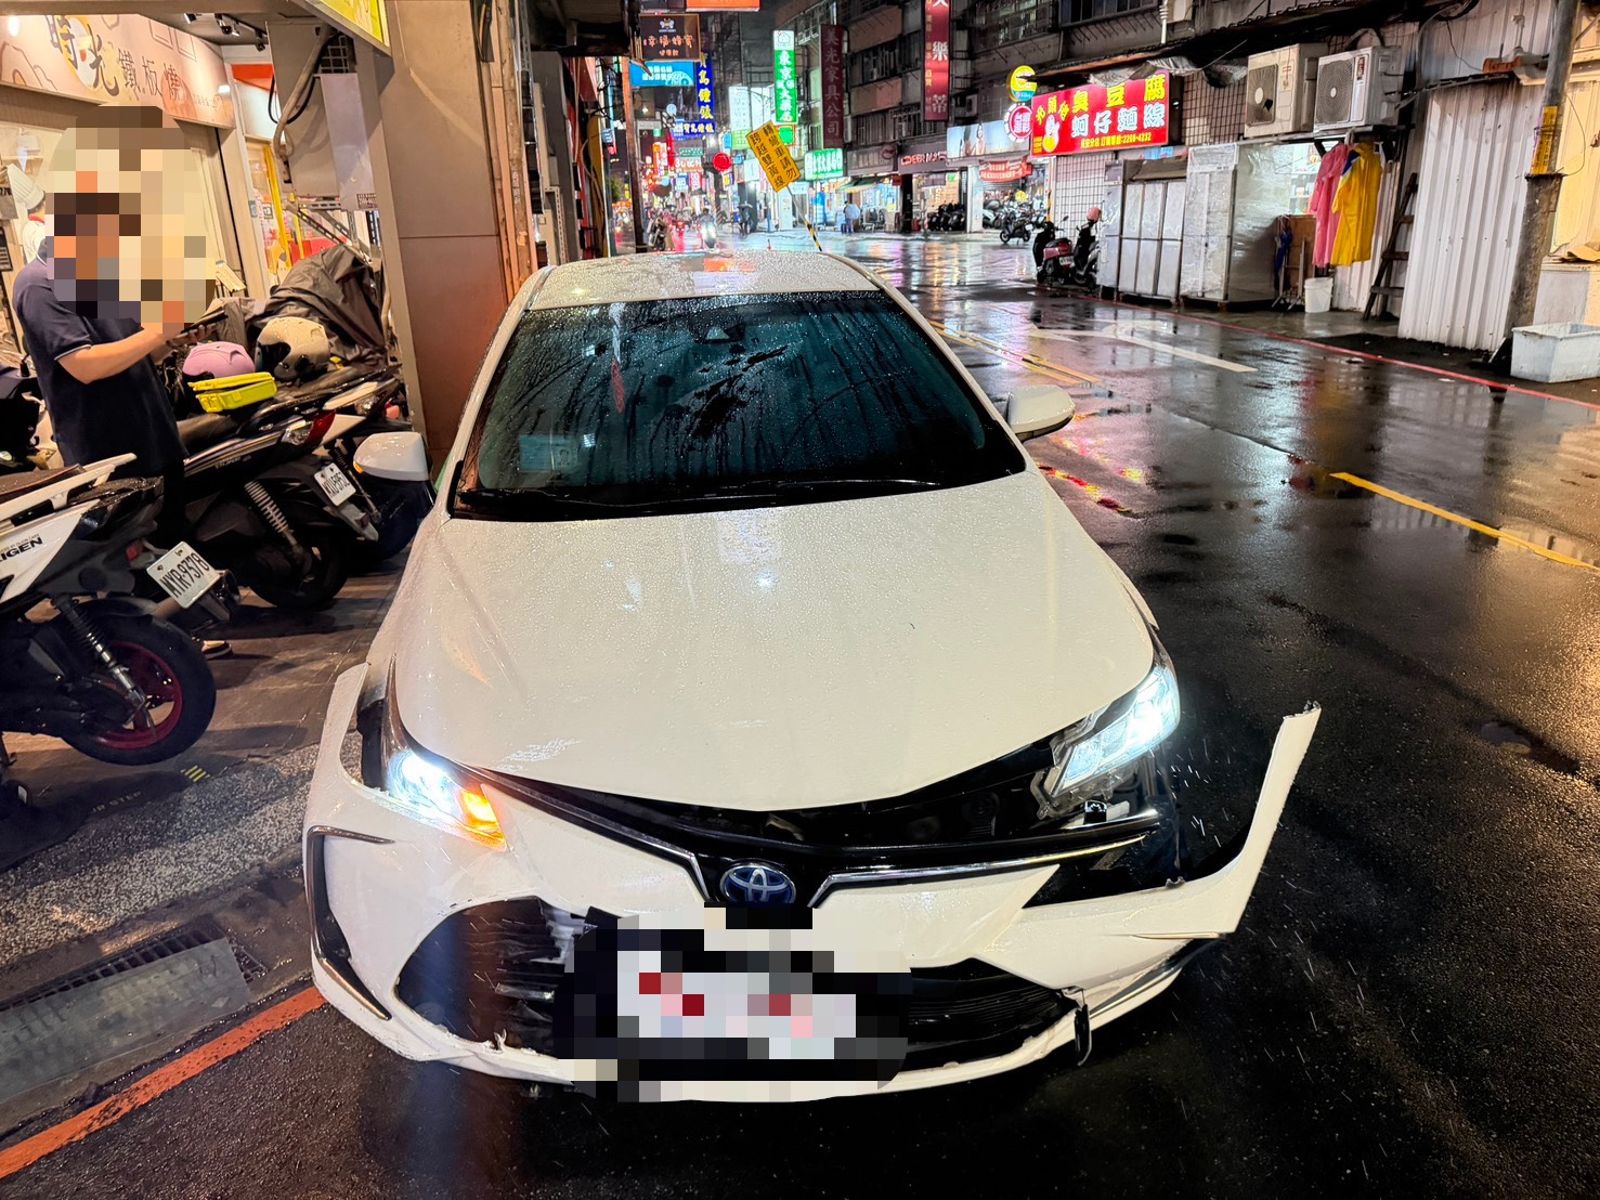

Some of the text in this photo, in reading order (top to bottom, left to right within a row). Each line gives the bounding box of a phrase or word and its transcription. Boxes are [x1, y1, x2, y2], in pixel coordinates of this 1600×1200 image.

[1072, 74, 1165, 113] 臭豆腐
[0, 536, 43, 561] IGEN
[160, 552, 210, 598] MYR-9378
